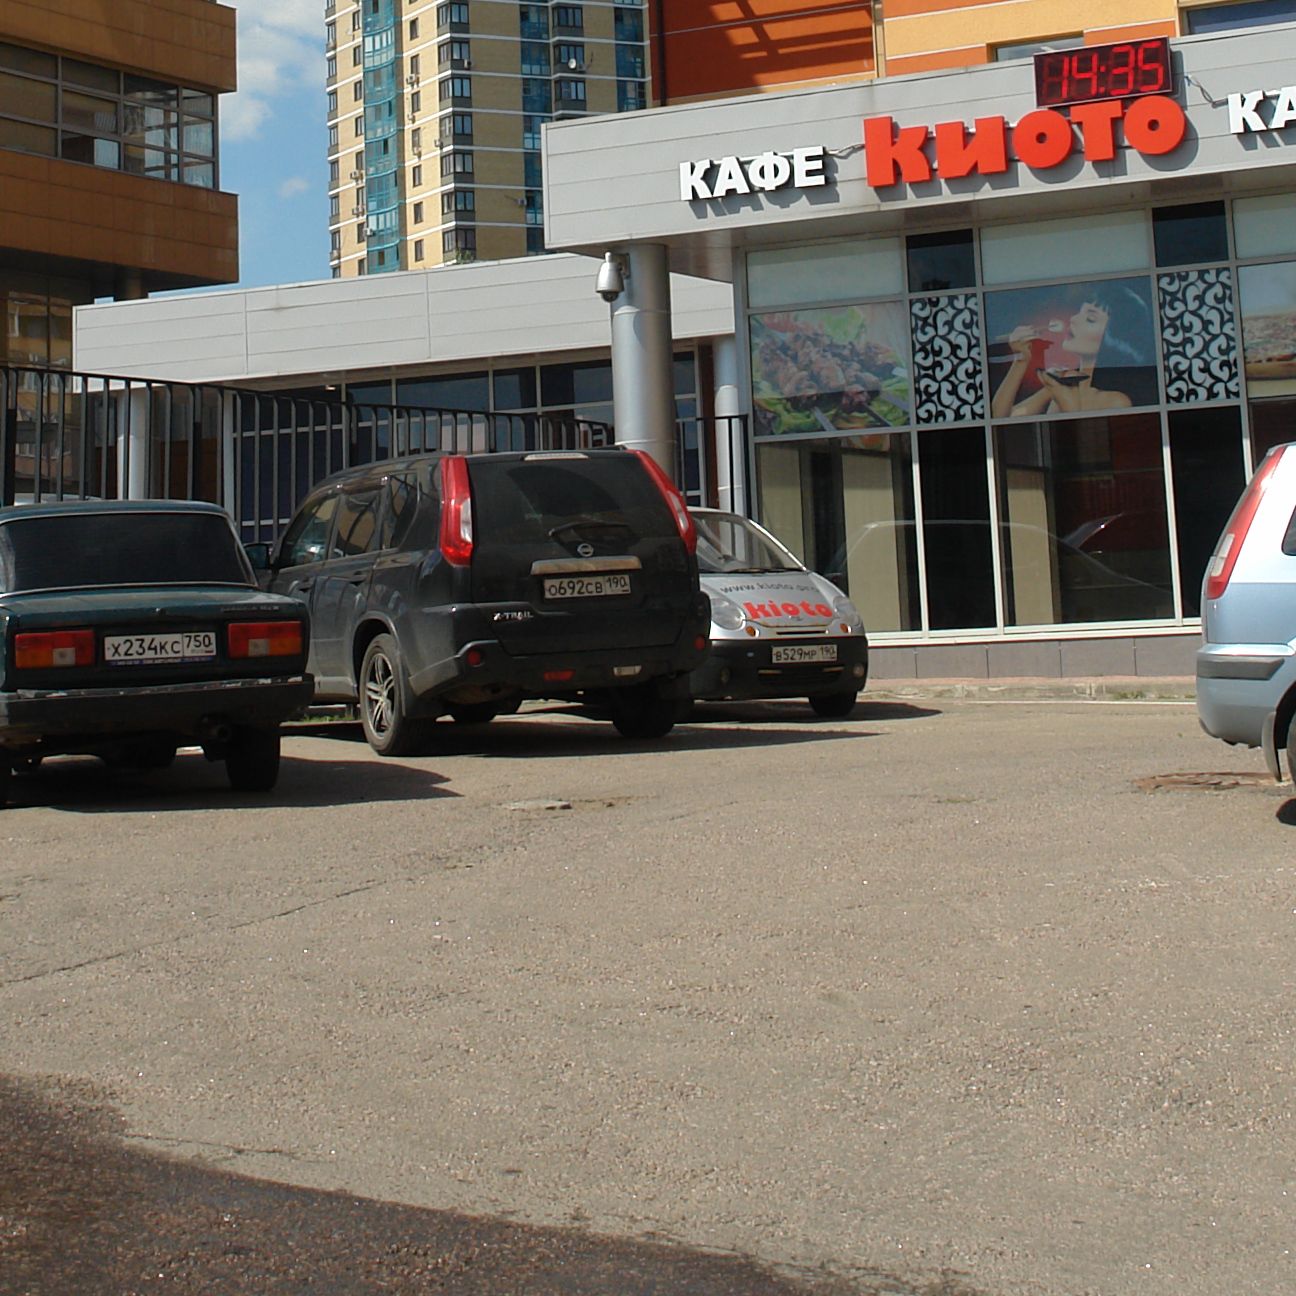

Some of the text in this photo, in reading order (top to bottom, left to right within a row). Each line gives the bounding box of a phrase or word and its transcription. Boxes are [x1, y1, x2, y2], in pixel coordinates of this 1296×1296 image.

[1061, 41, 1165, 99] 14:35
[679, 145, 826, 201] КАФЕ
[493, 610, 534, 621] X-TRAIL
[743, 600, 833, 620] kioto
[184, 634, 211, 649] 750
